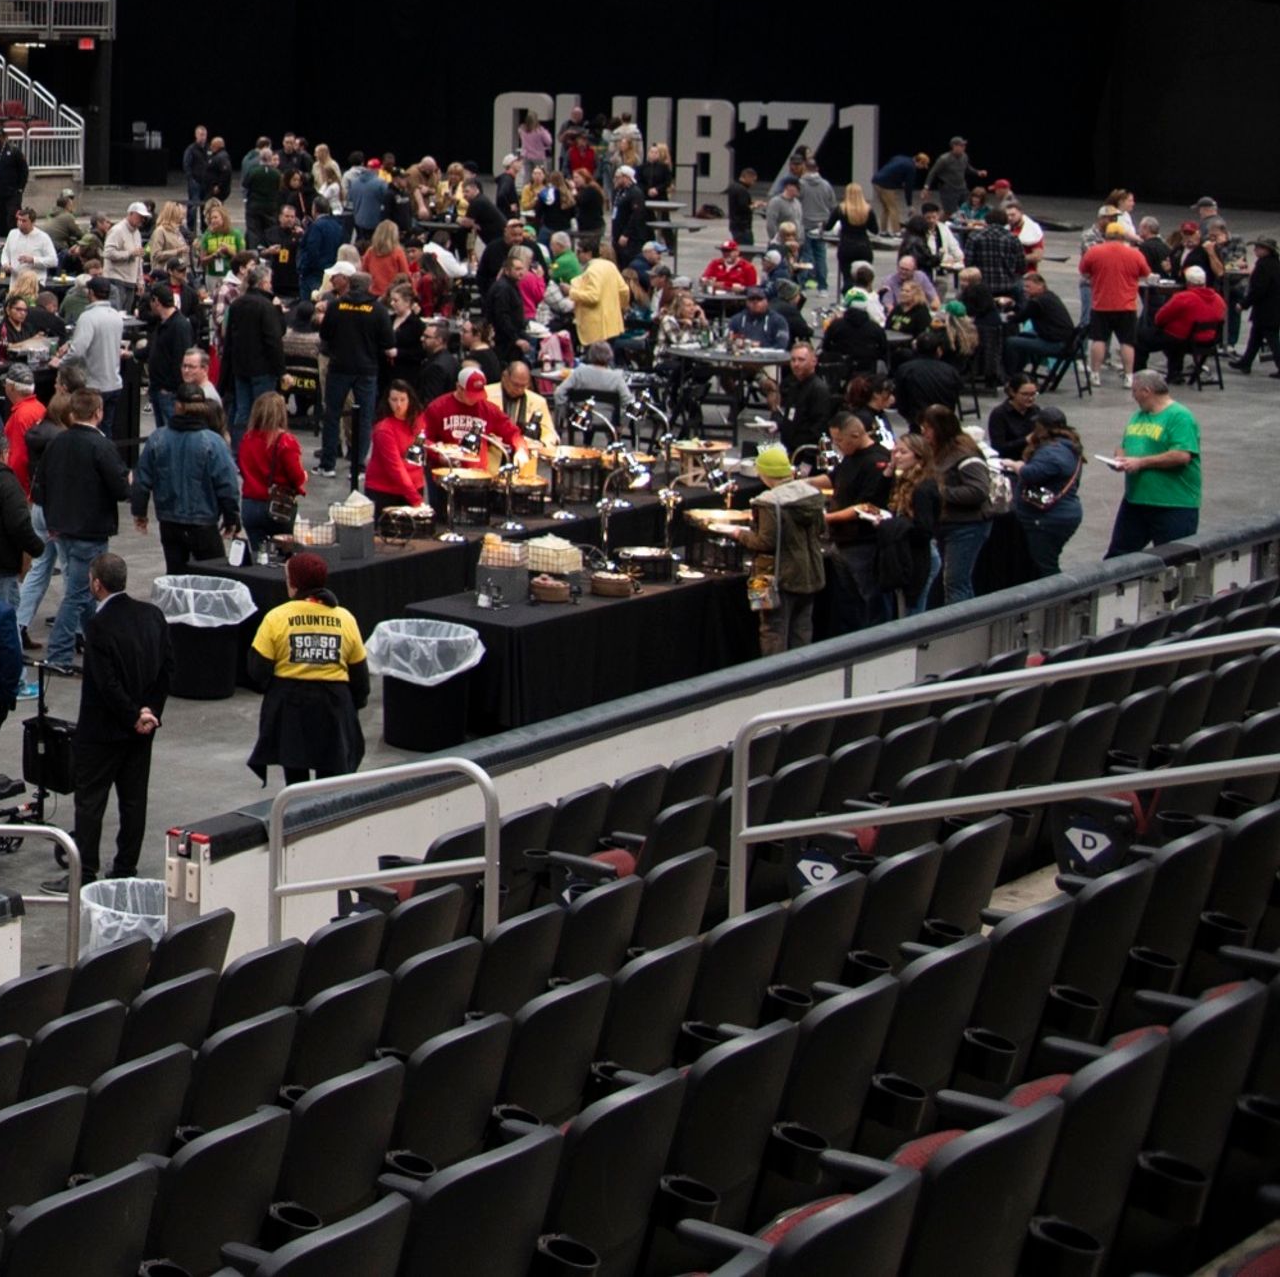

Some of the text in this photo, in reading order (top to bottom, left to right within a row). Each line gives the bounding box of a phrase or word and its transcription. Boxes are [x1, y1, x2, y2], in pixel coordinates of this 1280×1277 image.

[288, 614, 341, 628] VOLUNTEER
[295, 647, 337, 660] RAFFLE
[1081, 833, 1097, 850] D
[810, 864, 824, 880] C
